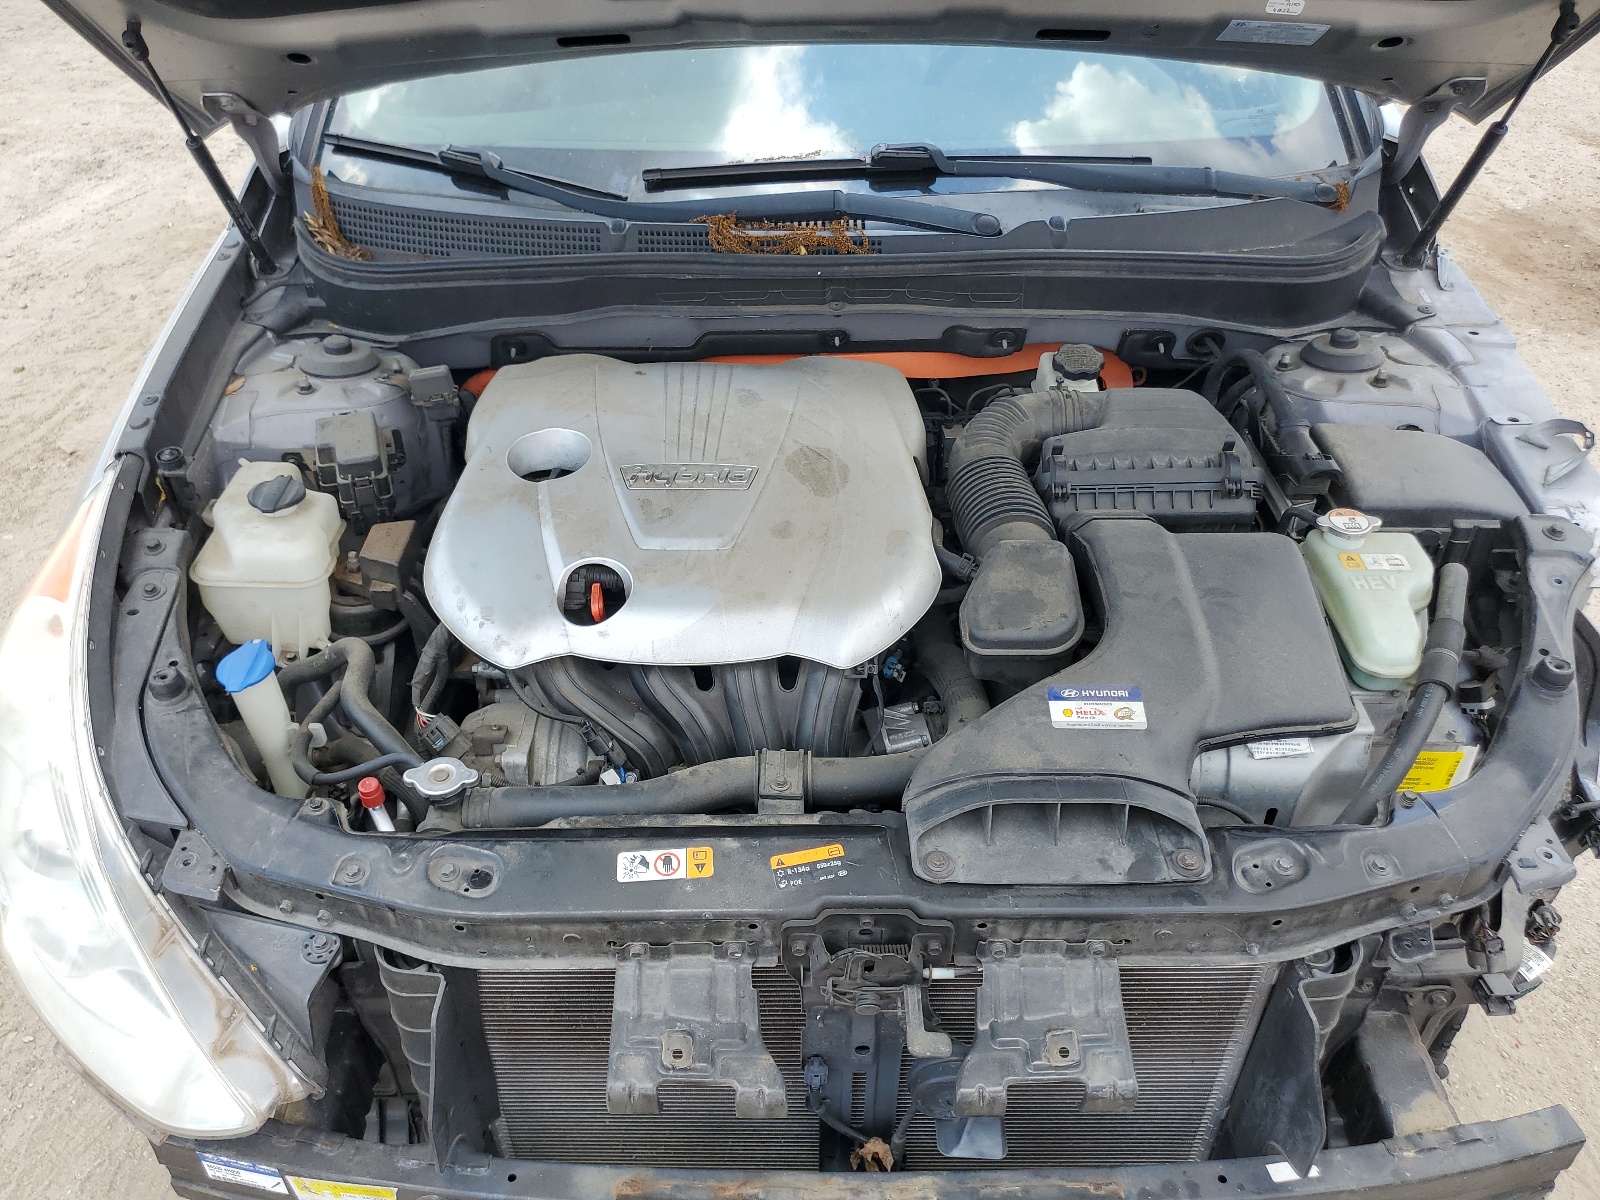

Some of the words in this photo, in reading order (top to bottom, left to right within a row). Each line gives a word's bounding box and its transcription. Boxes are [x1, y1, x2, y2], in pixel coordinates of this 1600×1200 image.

[1351, 574, 1398, 591] HEV
[1081, 690, 1129, 698] HYUNDAI
[787, 865, 811, 875] R-134a
[789, 879, 803, 887] POE
